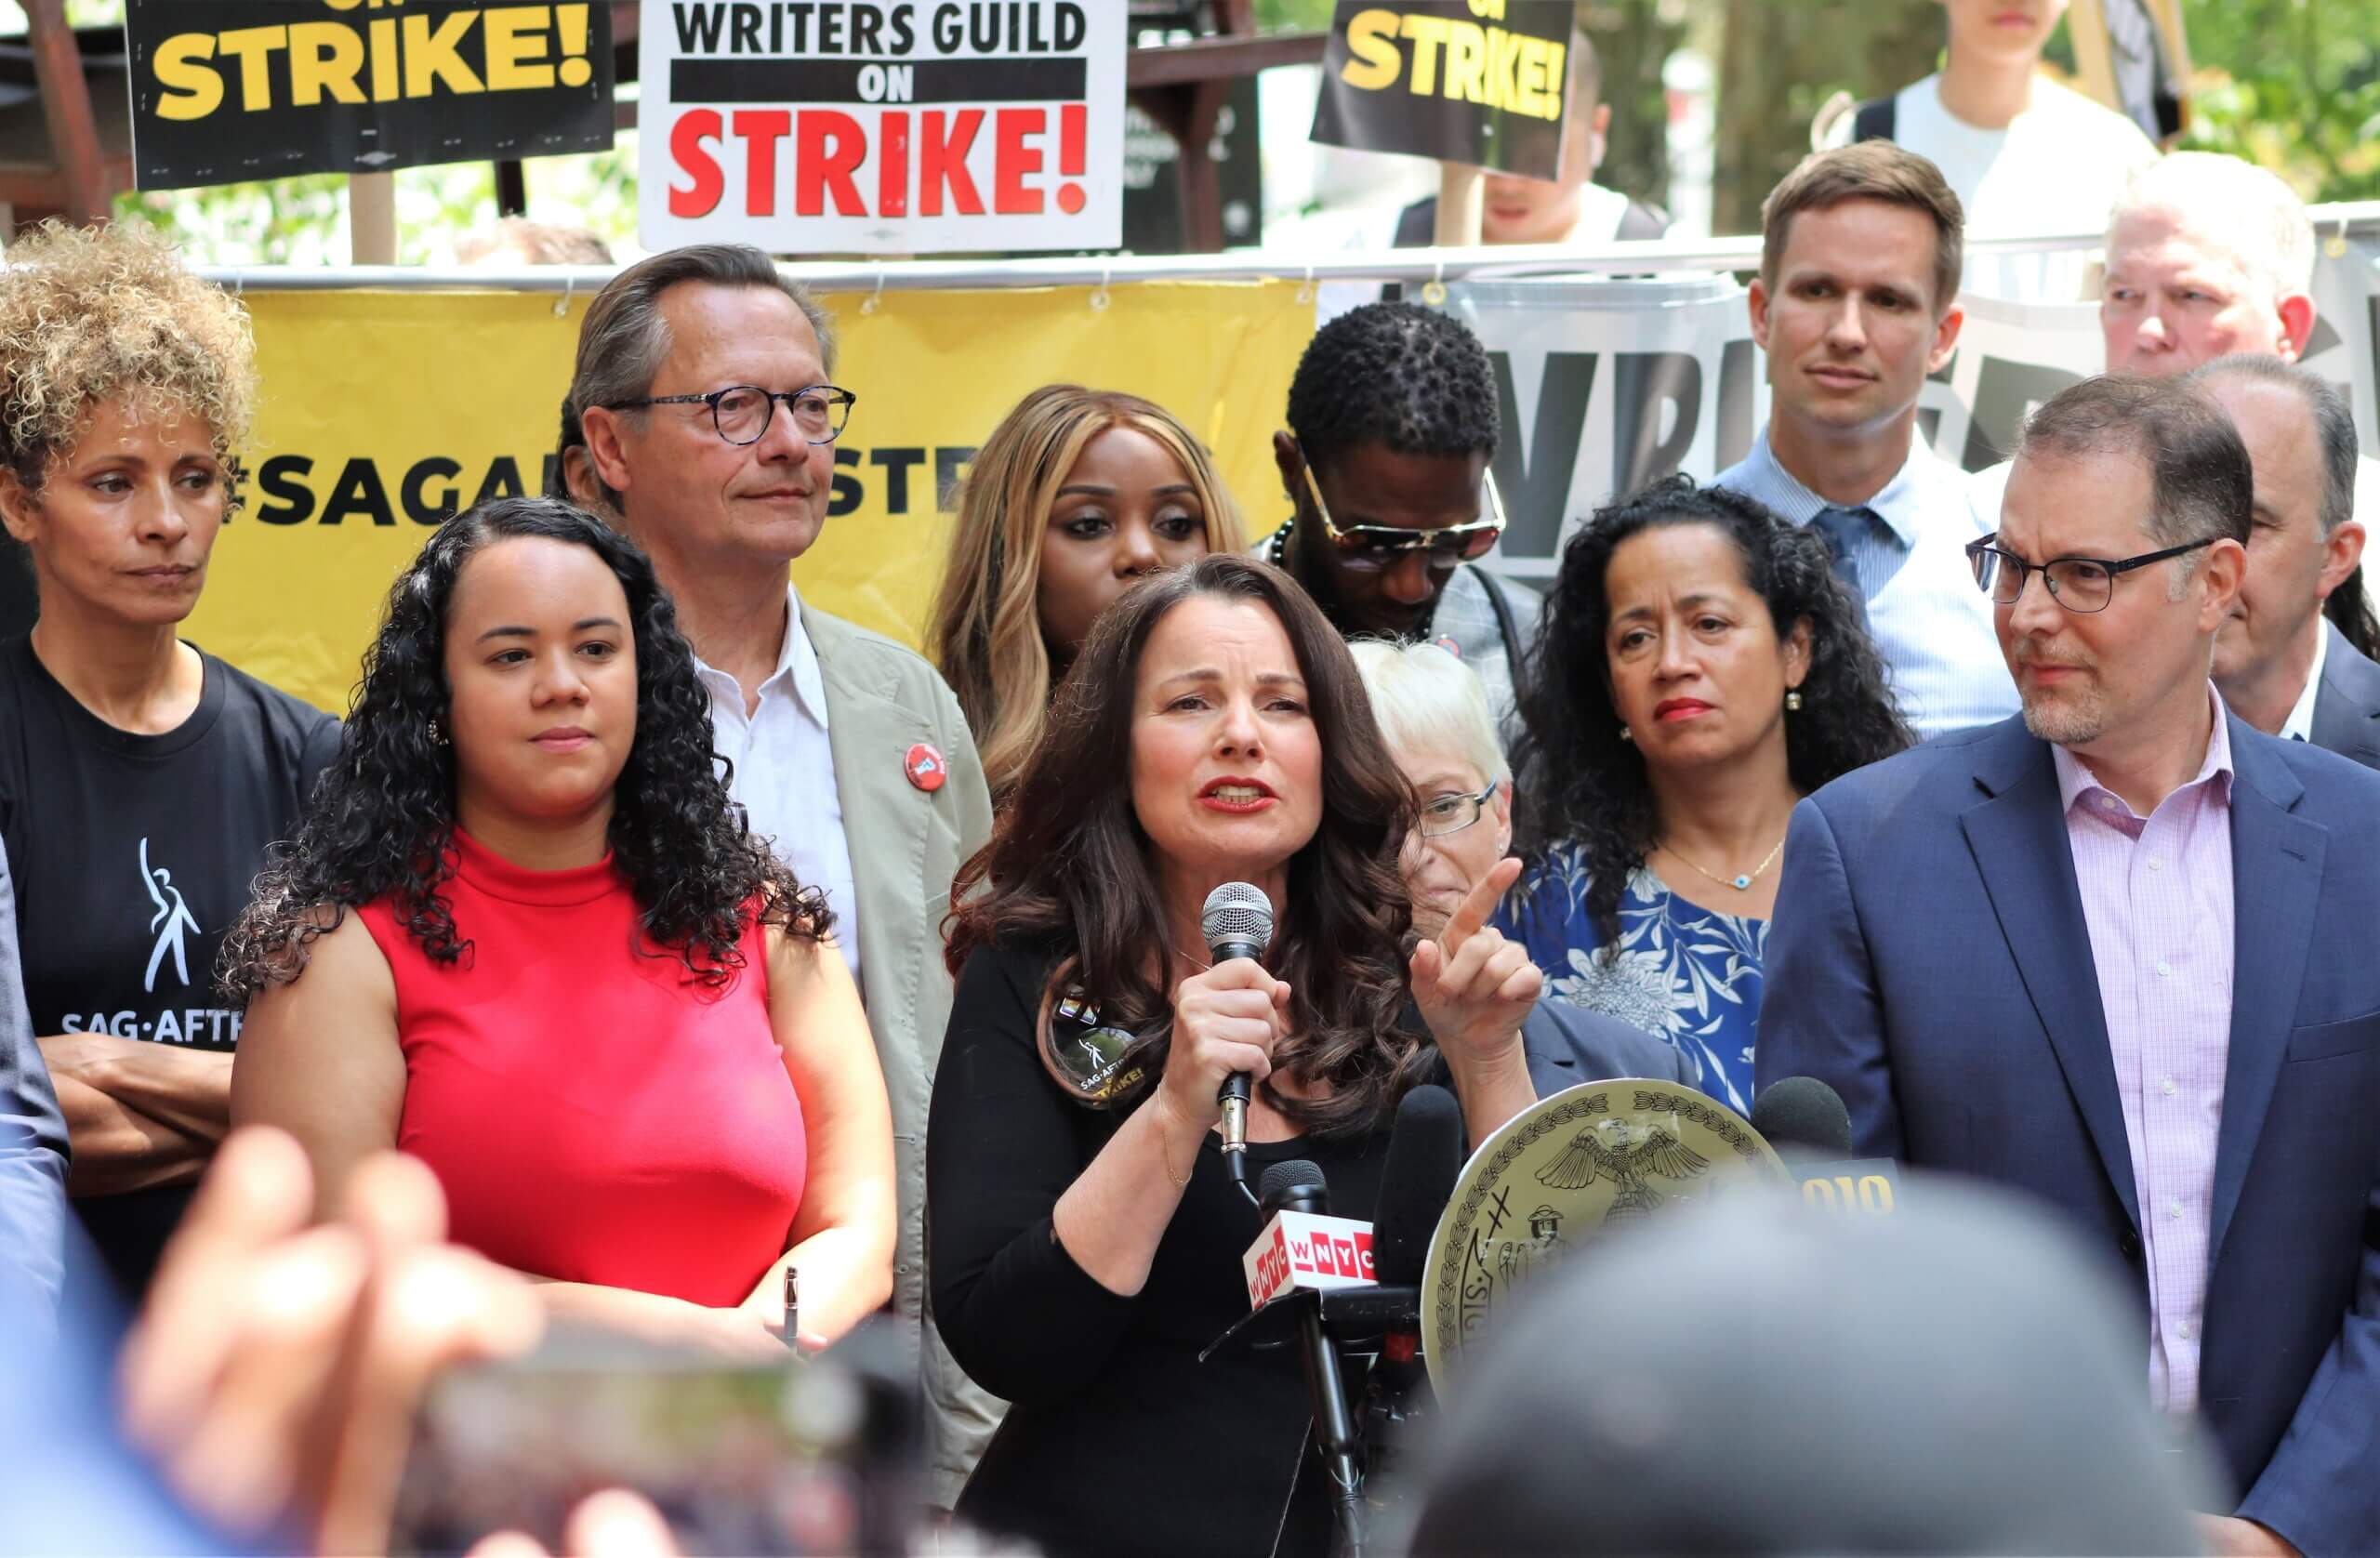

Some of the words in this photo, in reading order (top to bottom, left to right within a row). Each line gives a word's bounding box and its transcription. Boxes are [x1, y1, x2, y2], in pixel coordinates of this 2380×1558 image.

[672, 2, 915, 55] WRITERS
[932, 2, 1087, 54] GUILD
[154, 3, 593, 121] STRIKE!
[856, 64, 913, 102] ON
[1342, 8, 1566, 121] STRIKE!
[668, 104, 1088, 218] STRIKE!
[1250, 1241, 1288, 1300] WNYC
[1289, 1237, 1376, 1272] WNYC
